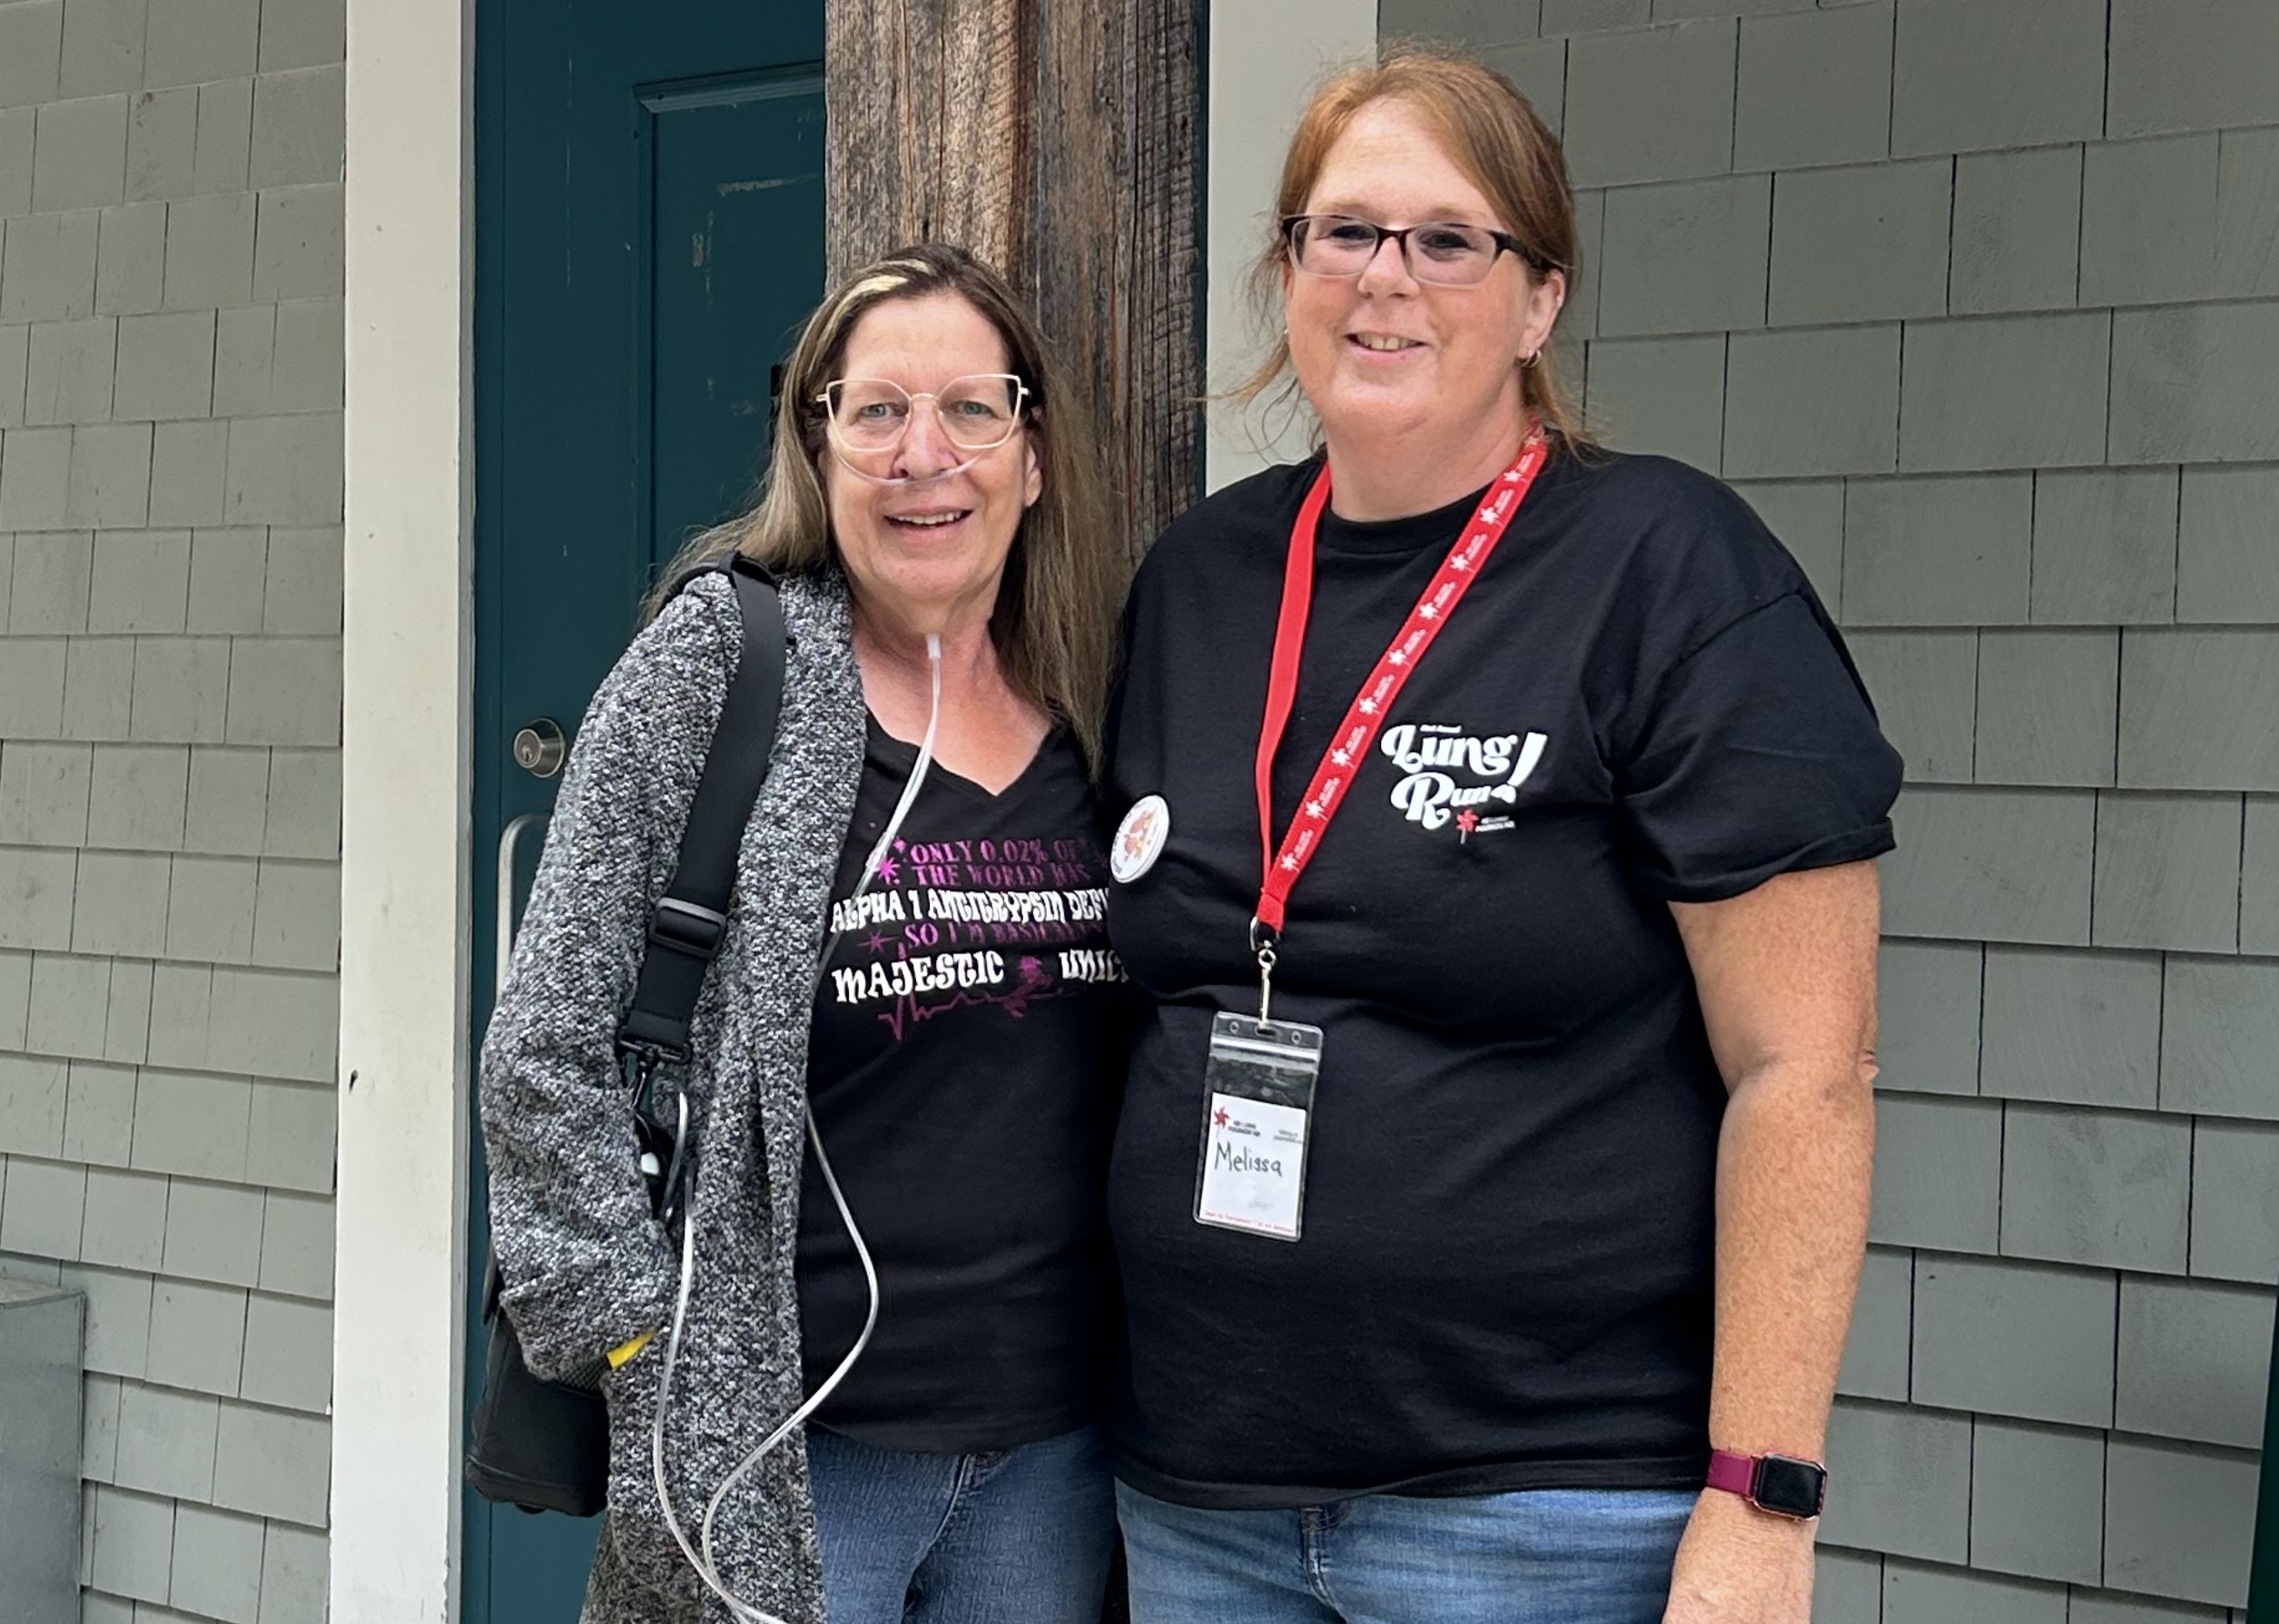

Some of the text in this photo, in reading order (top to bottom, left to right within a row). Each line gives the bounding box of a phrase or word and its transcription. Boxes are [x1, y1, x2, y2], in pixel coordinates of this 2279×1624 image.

[910, 840, 972, 864] ONLY
[981, 838, 1049, 863] 0.02%
[912, 863, 962, 886] THE
[967, 861, 1045, 888] WORLD
[830, 889, 906, 933] ALPHA
[903, 921, 939, 949] SO
[831, 950, 1005, 1005] MAJESTIC
[1215, 1140, 1283, 1177] Melissa
